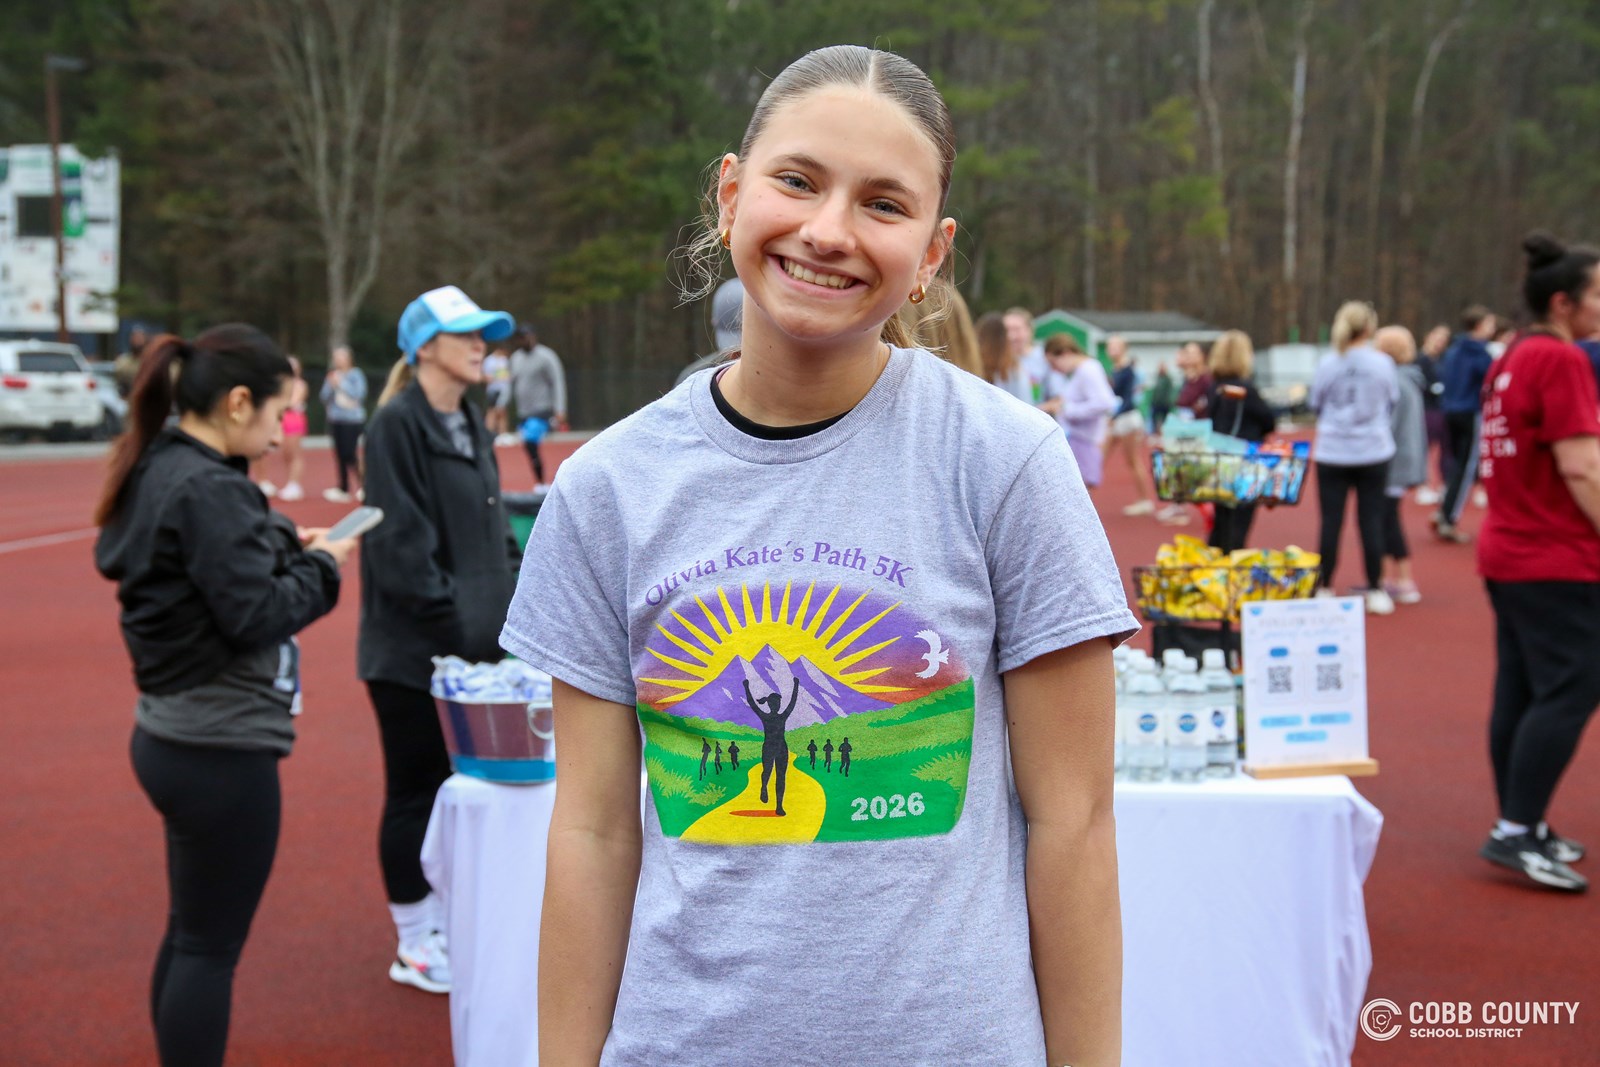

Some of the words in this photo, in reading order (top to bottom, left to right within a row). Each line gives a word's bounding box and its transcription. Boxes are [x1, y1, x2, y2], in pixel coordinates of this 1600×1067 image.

[645, 559, 718, 606] Olivia
[811, 541, 867, 572] Path
[872, 555, 914, 588] 5K
[850, 791, 926, 822] 2026
